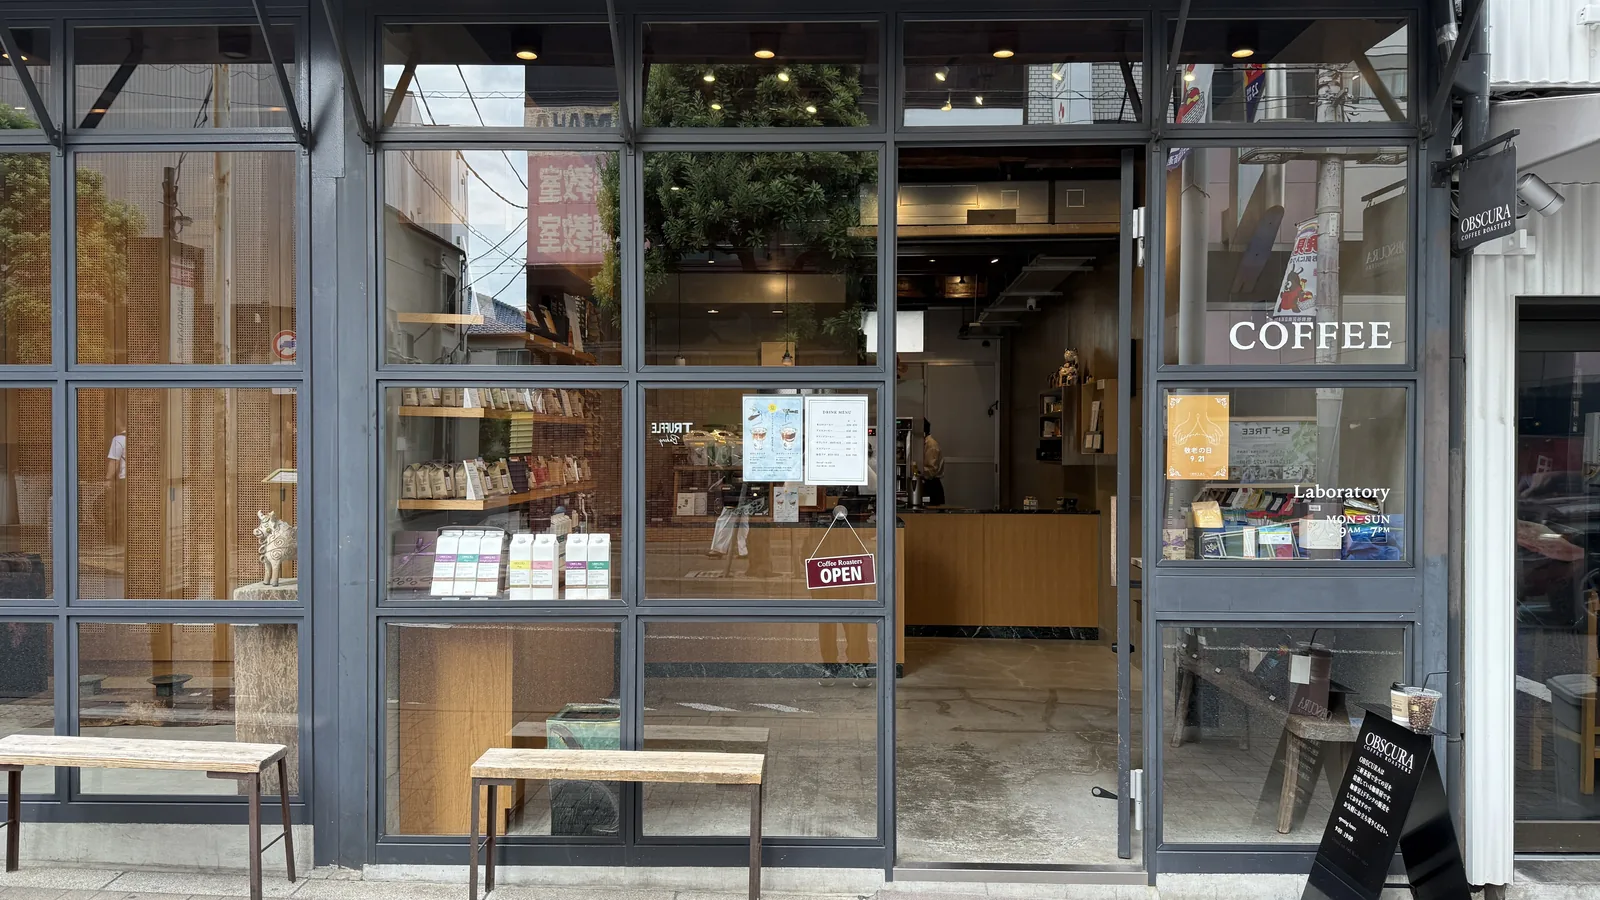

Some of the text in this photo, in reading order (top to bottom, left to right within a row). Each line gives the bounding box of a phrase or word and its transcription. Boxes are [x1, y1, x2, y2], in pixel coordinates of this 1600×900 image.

[1460, 204, 1511, 234] OBSCURA
[1461, 220, 1512, 242] COFFEE ROASTERS
[1229, 321, 1393, 350] COFFEE
[1294, 484, 1391, 502] Laboratory
[817, 558, 863, 568] Coffee Roasters
[820, 565, 862, 584] OPEN
[1363, 745, 1412, 775] COFFEE ROASTERS
[1365, 732, 1414, 770] OBSCURA
